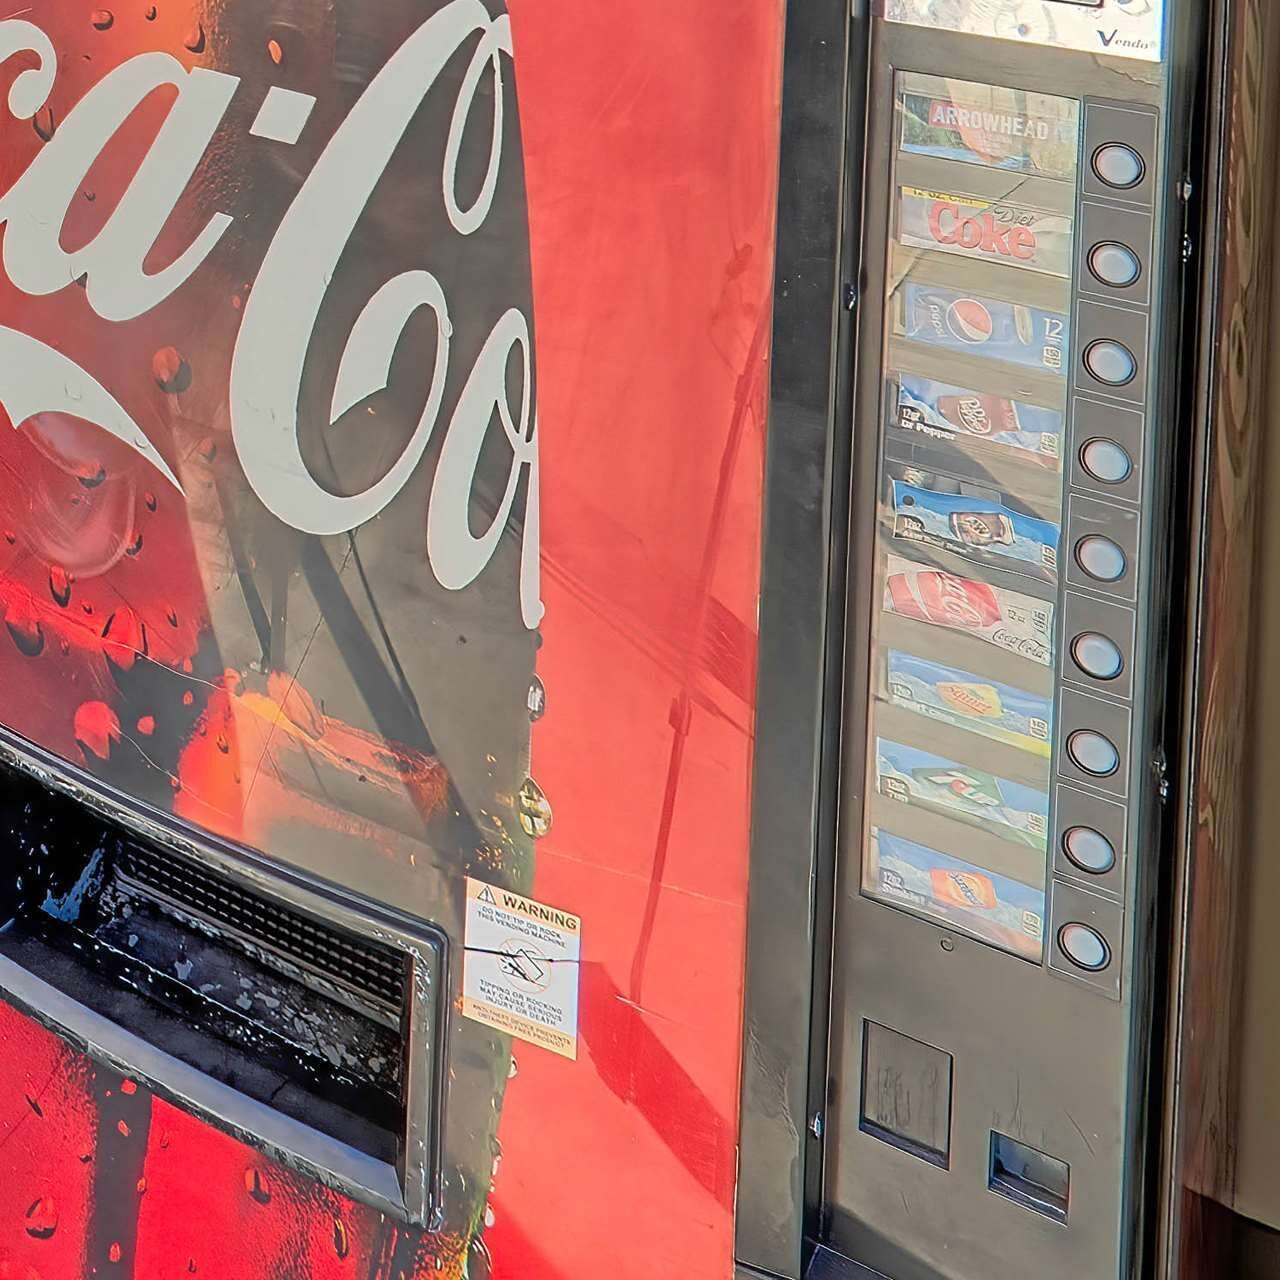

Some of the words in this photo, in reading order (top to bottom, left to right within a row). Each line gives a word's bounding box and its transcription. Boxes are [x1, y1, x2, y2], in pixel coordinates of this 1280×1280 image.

[1096, 28, 1149, 50] Vendo
[931, 103, 1050, 141] ARROWHEAD
[927, 200, 1037, 260] Coke
[993, 206, 1035, 226] Diet
[1043, 317, 1064, 340] 12
[915, 422, 958, 441] Pepper
[992, 628, 1047, 660] Coca-Cola
[477, 910, 494, 923] THIS
[495, 917, 530, 936] VENDING
[531, 930, 567, 949] MACHINE
[481, 905, 494, 915] DO
[495, 909, 511, 921] NOT
[513, 915, 525, 926] TIP
[526, 921, 538, 932] OR
[539, 926, 563, 940] ROCK
[502, 893, 578, 931] WARNING
[479, 985, 496, 997] MAY
[498, 992, 526, 1008] CAUSE
[527, 1004, 563, 1023] SERIOUS
[480, 978, 511, 997] TIPPING
[512, 991, 525, 1001] OR
[526, 995, 563, 1016] ROCKING
[485, 994, 513, 1011] INJURY
[515, 1005, 528, 1017] OR
[529, 1010, 557, 1026] DEATH
